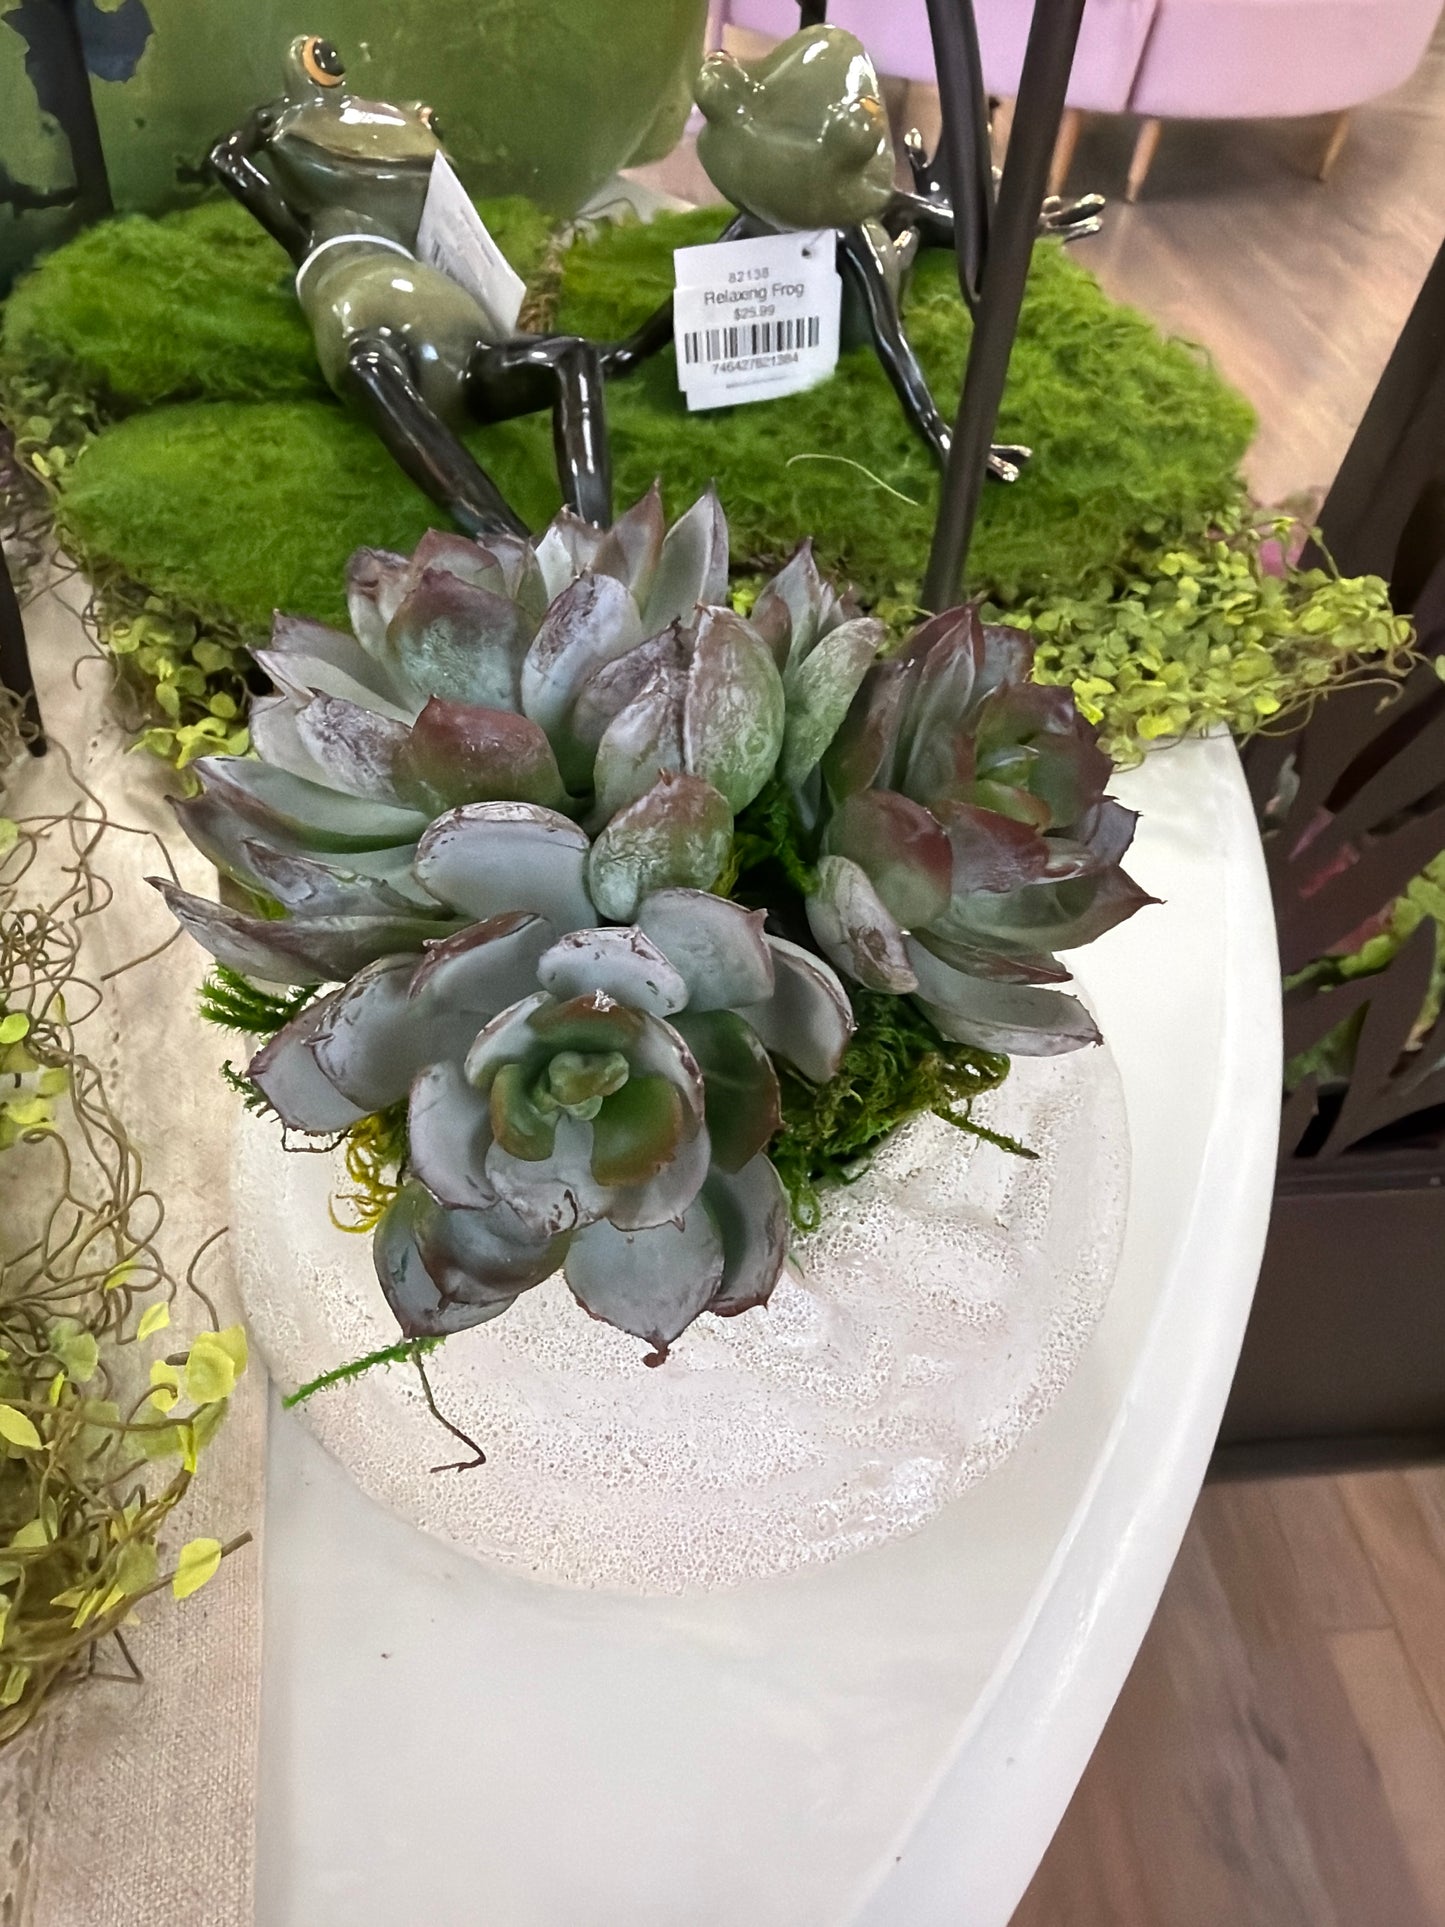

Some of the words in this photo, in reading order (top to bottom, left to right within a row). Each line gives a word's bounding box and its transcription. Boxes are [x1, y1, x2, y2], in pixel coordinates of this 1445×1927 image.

[728, 267, 769, 283] 82138
[704, 287, 768, 305] Relaxing
[772, 283, 805, 298] Frog
